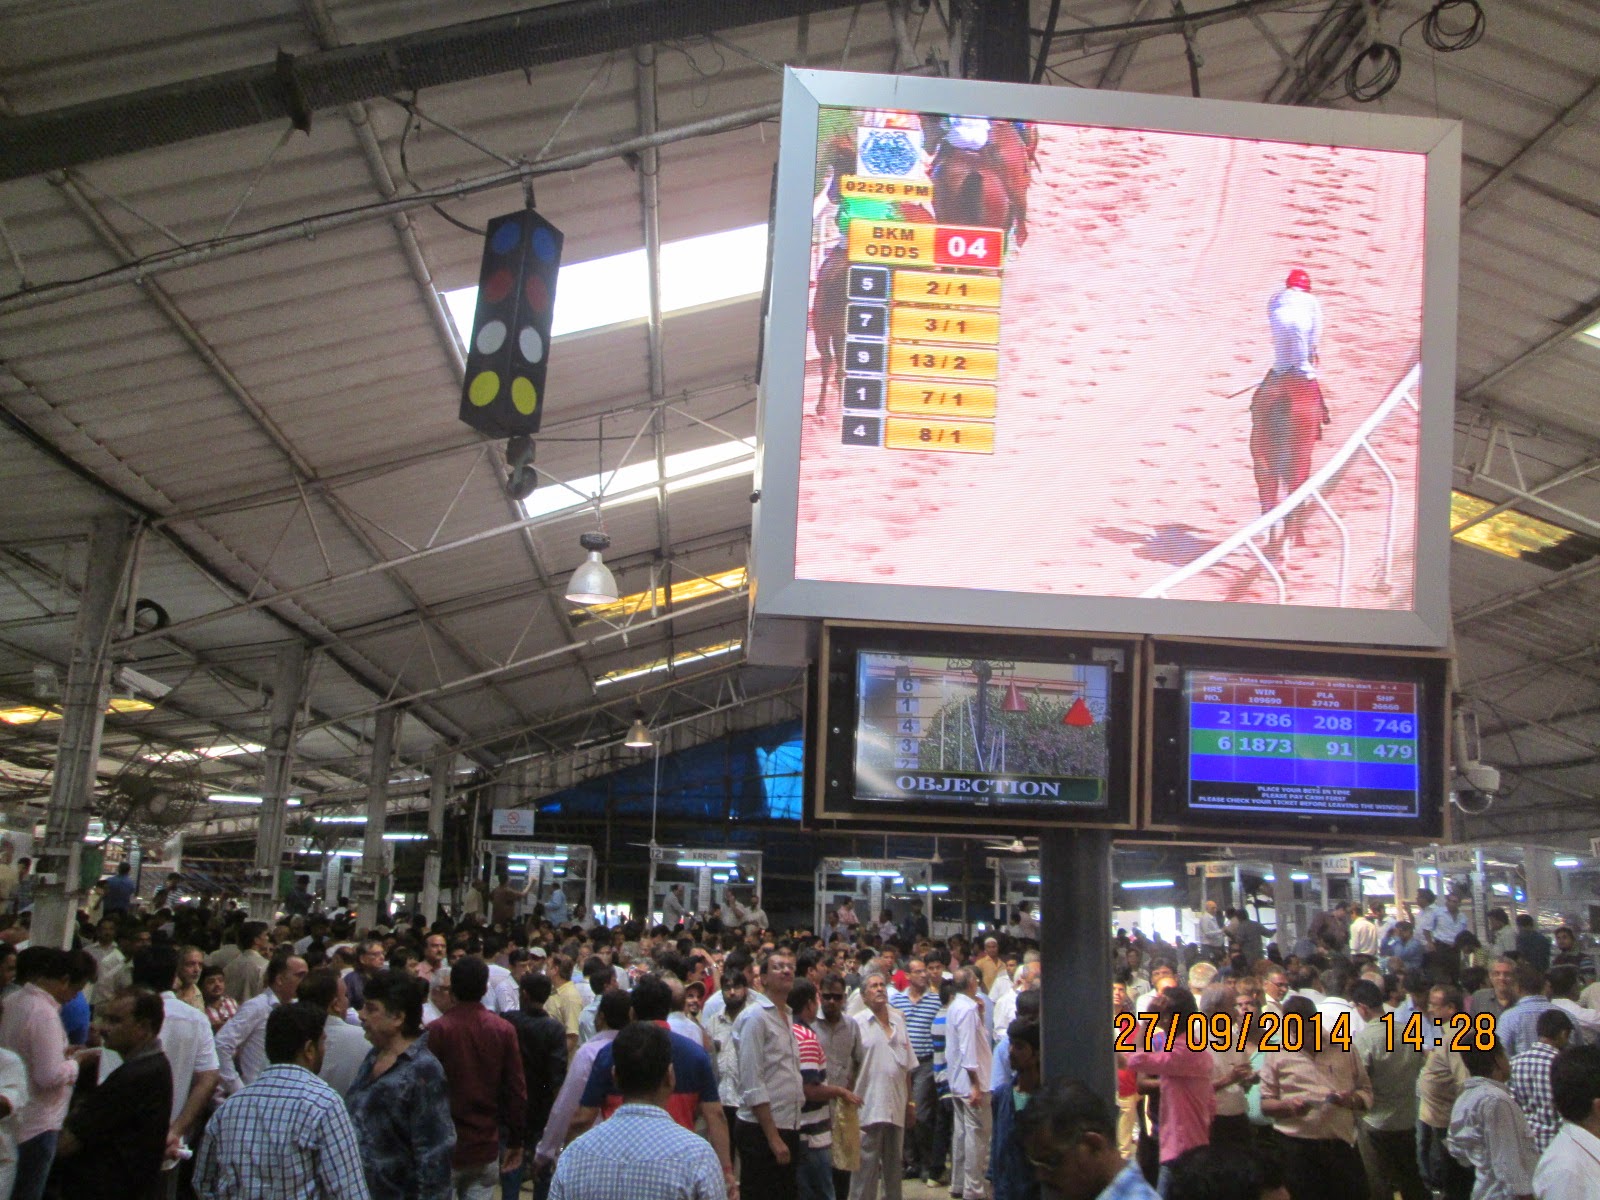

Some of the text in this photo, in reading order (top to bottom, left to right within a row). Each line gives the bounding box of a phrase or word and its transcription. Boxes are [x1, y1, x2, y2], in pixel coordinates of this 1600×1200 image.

[845, 181, 929, 196] 02:26 PM
[873, 227, 915, 241] BKM
[866, 244, 919, 258] ODDS
[948, 236, 987, 259] 04
[862, 278, 874, 290] 5
[859, 314, 872, 327] 7
[857, 388, 866, 400] 1
[853, 425, 866, 437] 4
[903, 679, 913, 691] 6
[902, 699, 909, 712] 1
[902, 719, 913, 732] 4
[1218, 711, 1412, 734] 2 1786 208 746
[902, 739, 912, 752] 3
[1218, 737, 1412, 759] 6 1873 91 479
[895, 776, 1061, 797] OBJECTION
